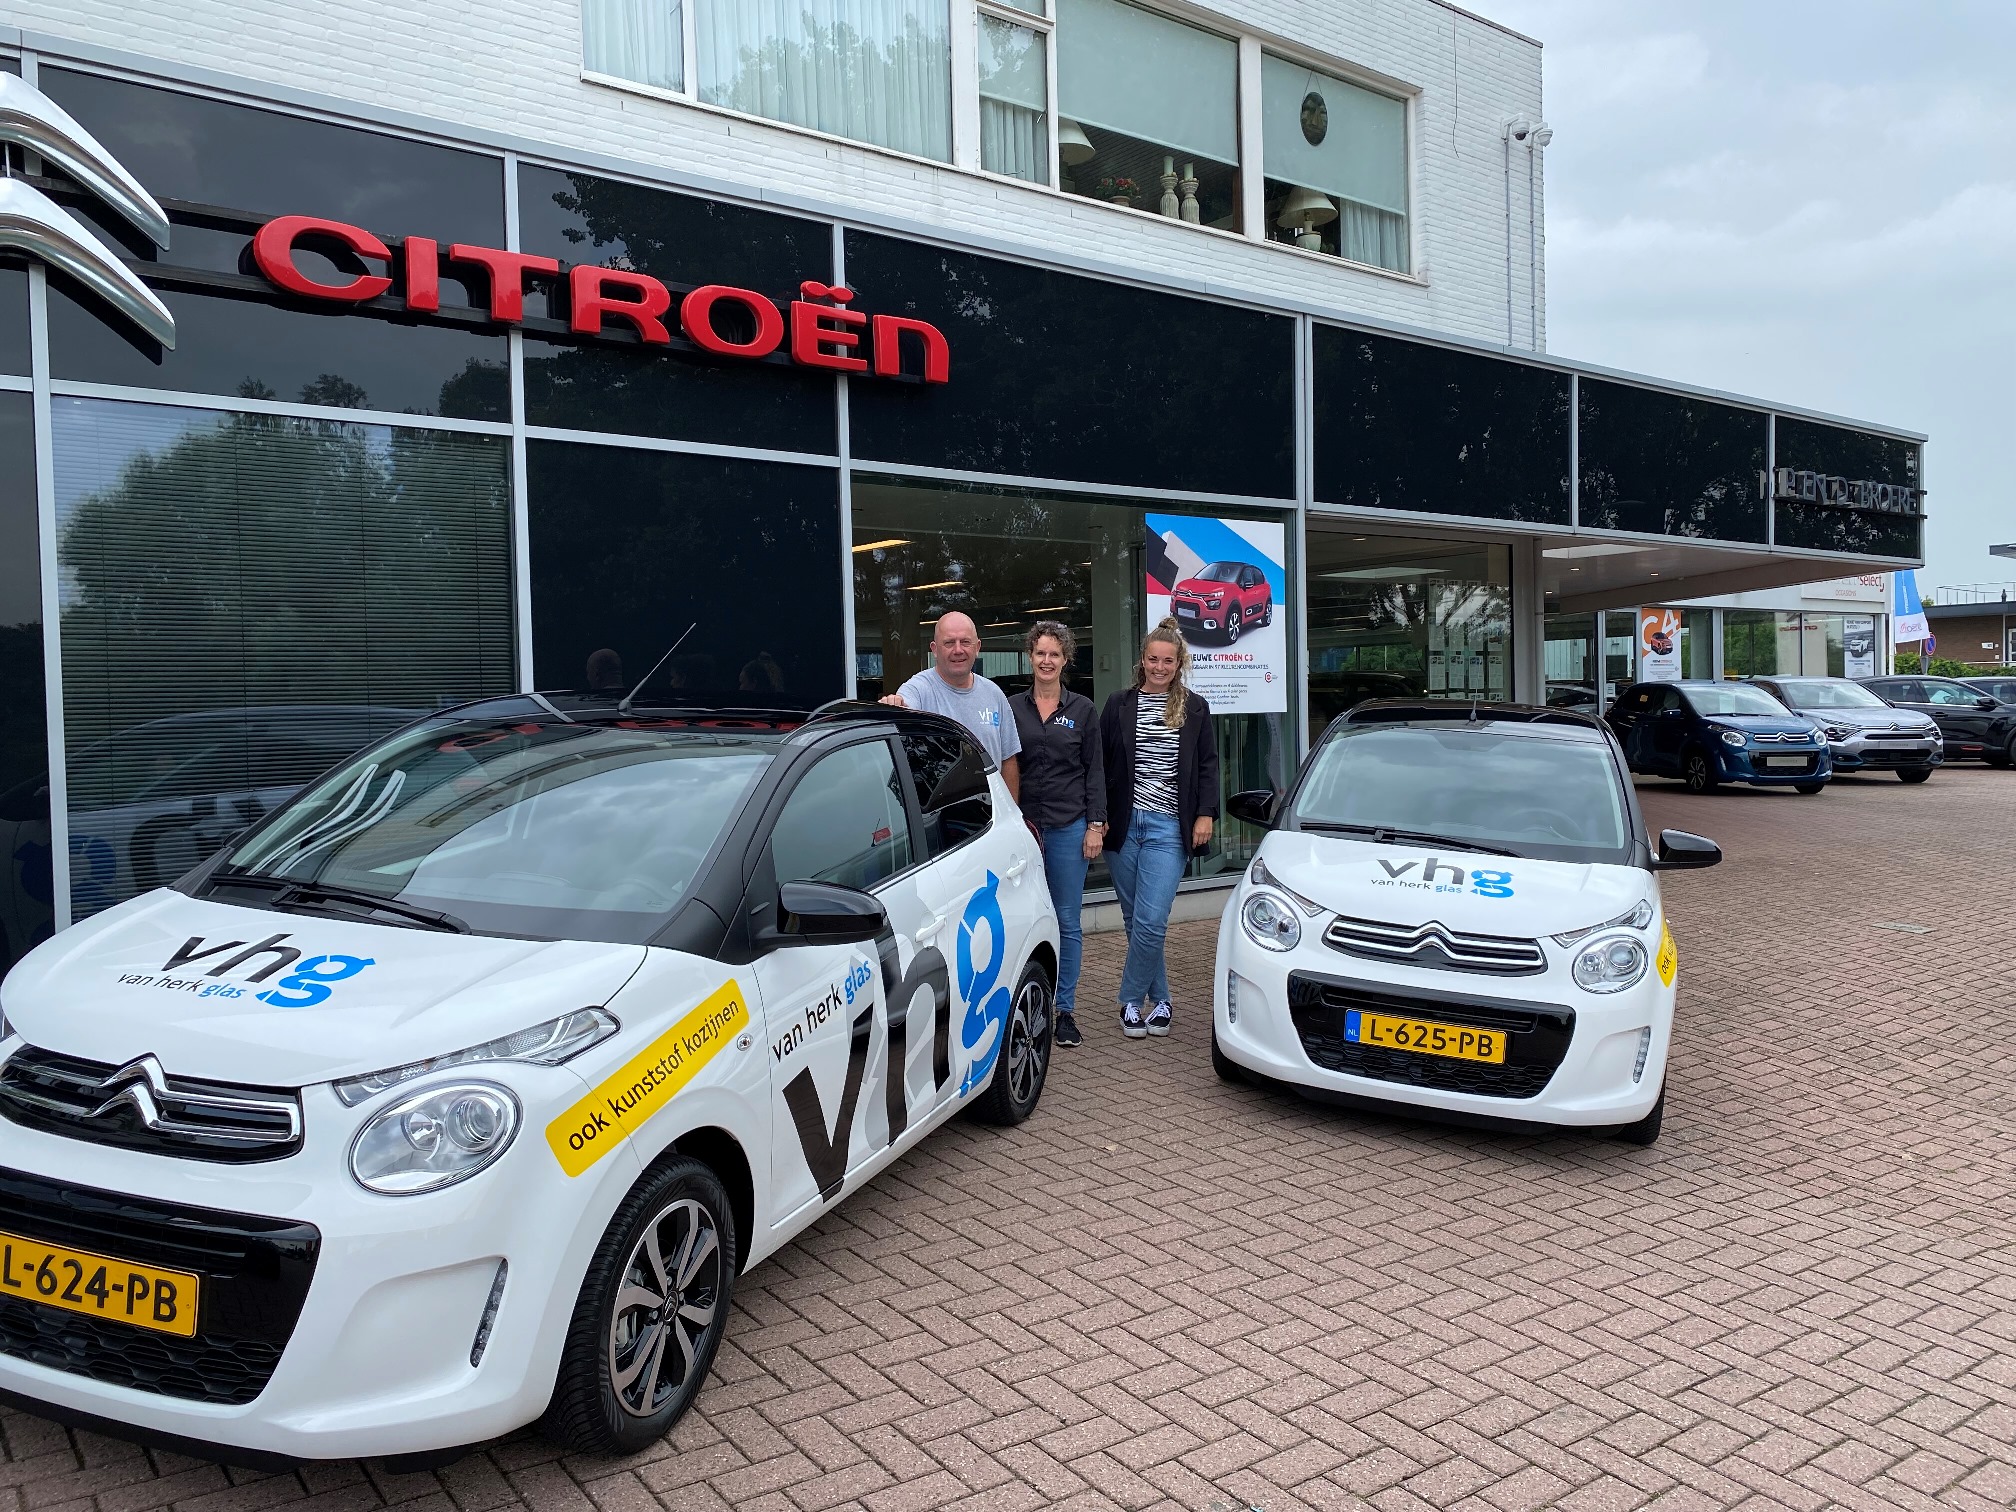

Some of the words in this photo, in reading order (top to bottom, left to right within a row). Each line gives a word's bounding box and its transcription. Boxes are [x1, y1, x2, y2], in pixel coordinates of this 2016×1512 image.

[252, 215, 949, 385] CITROËN
[1213, 653, 1243, 662] CITROËN
[1244, 653, 1254, 662] C3
[978, 708, 999, 727] vhg
[1055, 715, 1075, 729] vhg
[1370, 878, 1395, 886] van
[1399, 880, 1431, 890] herk
[1435, 884, 1463, 893] glas
[1376, 857, 1515, 898] vhg
[117, 973, 153, 983] van
[154, 975, 204, 992] herk
[198, 982, 247, 999] glas
[161, 933, 376, 1008] vhg
[772, 1030, 805, 1063] van
[805, 982, 844, 1036] herk
[843, 958, 872, 1005] glas
[782, 869, 1012, 1204] vhg
[1347, 1028, 1359, 1037] NL
[1370, 1018, 1493, 1057] L-625-PB
[568, 1108, 612, 1152] ook
[606, 1045, 685, 1119] kunststof
[681, 998, 741, 1057] kozijnen
[3, 1244, 178, 1323] L-624-PB
